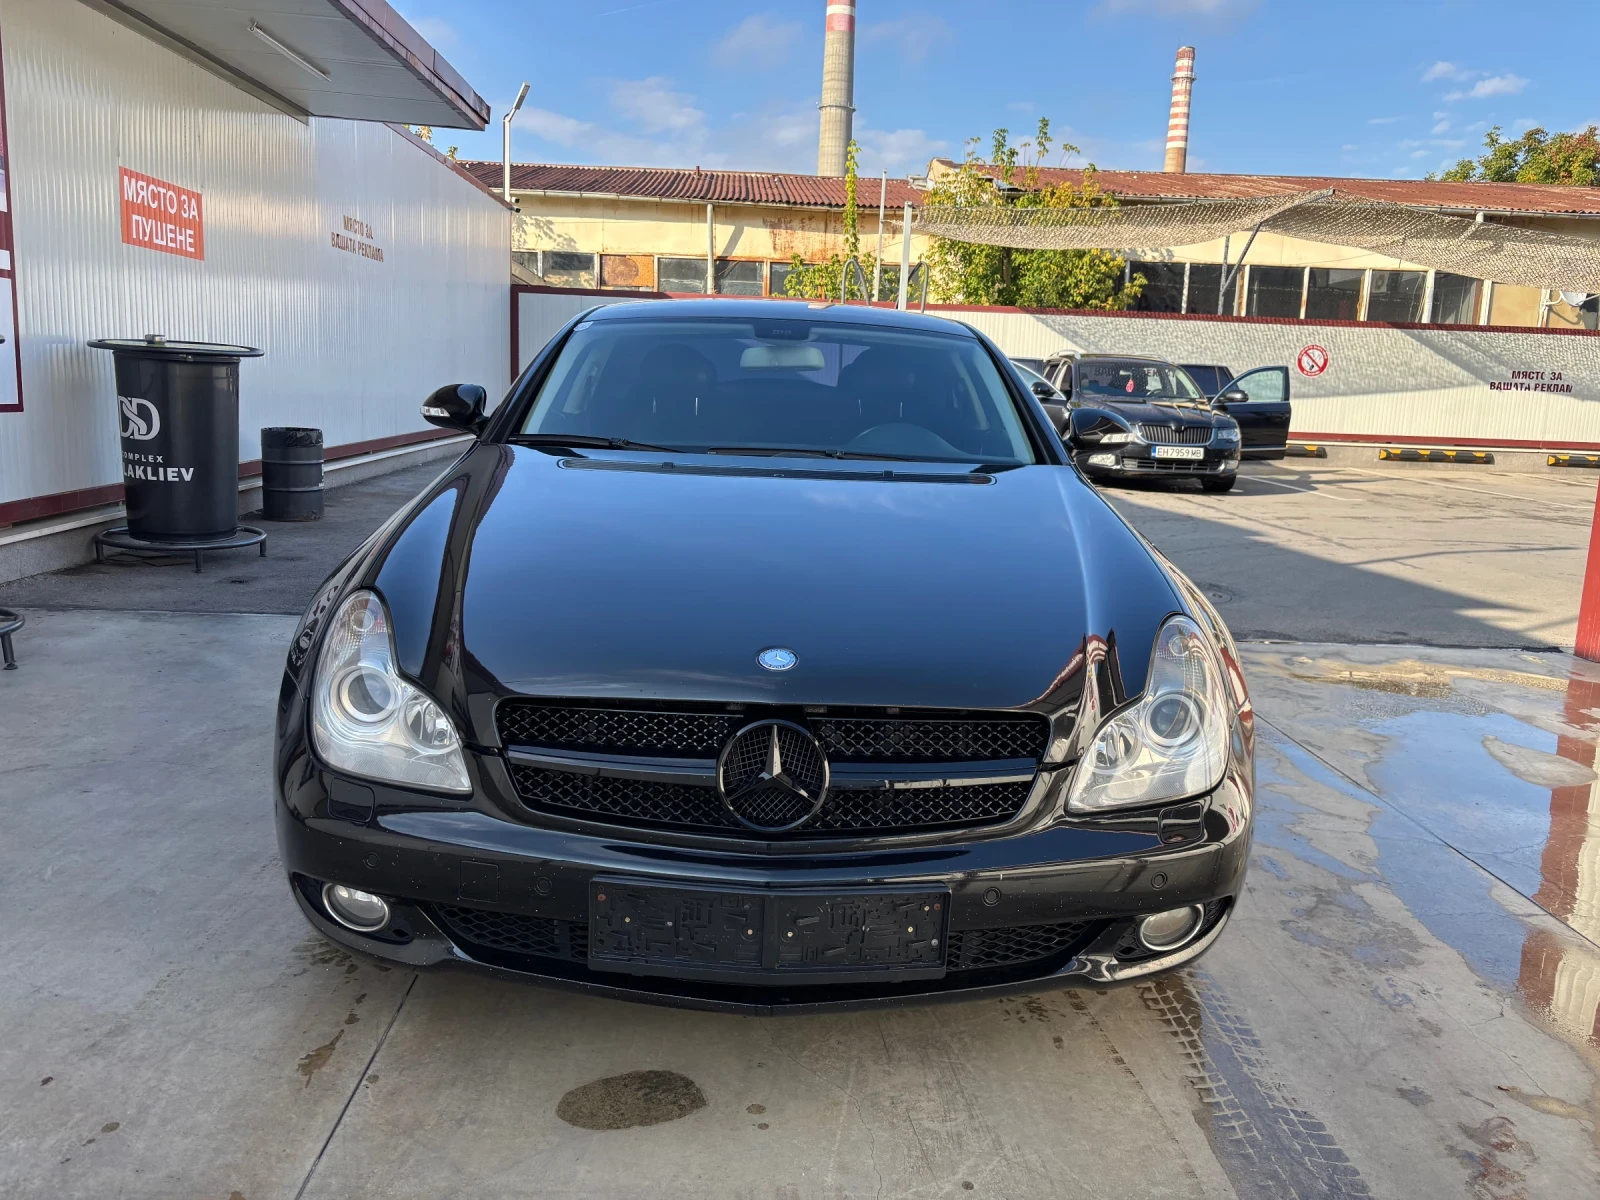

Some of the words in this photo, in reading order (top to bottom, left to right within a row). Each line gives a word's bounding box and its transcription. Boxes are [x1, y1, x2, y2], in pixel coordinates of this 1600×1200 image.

[123, 175, 177, 215] МЯСТО
[181, 194, 199, 222] ЗА
[132, 214, 195, 253] ПУШЕНЕ
[343, 215, 364, 237] МЯСТО
[331, 231, 357, 255] ВАШАТА
[1550, 371, 1563, 381] ЗА
[122, 450, 164, 463] OMPLEX
